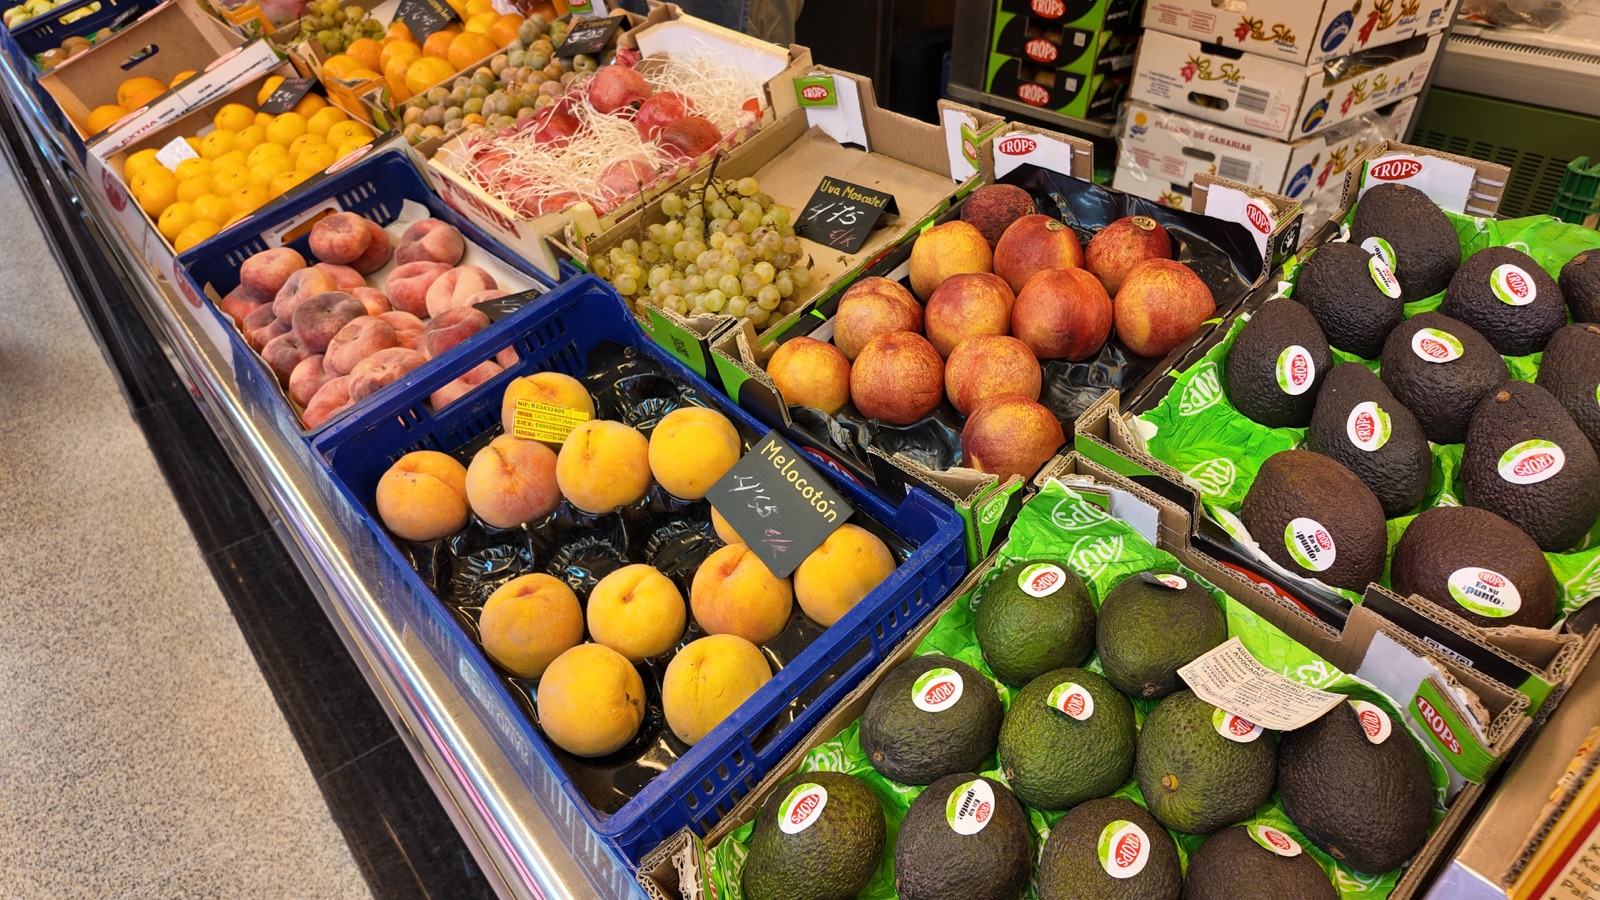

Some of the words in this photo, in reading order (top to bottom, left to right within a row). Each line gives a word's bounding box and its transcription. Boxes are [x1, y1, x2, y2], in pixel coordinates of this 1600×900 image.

[1032, 0, 1064, 17] TROPS
[1025, 41, 1058, 61] TROPS
[802, 86, 828, 100] TROPS
[1018, 84, 1049, 105] TROPS
[121, 119, 159, 146] EXTRA
[1193, 131, 1205, 140] DE
[1208, 135, 1252, 153] CANARIAS
[1001, 138, 1036, 155] TROPS
[1374, 161, 1420, 177] TROPS
[820, 179, 841, 197] Uva
[841, 185, 887, 208] Moscatel
[1247, 205, 1271, 233] TROPS
[1507, 271, 1528, 298] TROPS
[1420, 339, 1448, 359] TROPS
[1294, 355, 1306, 386] TROPS
[1356, 412, 1373, 442] TROPS
[1514, 453, 1555, 476] TROPS
[760, 439, 838, 524] Melocotón
[1307, 534, 1315, 545] En
[1313, 544, 1321, 553] su
[1316, 530, 1332, 551] TROPS
[1032, 571, 1059, 592] TROPS
[1474, 581, 1488, 590] En
[1488, 586, 1500, 595] su
[1478, 572, 1506, 588] TROPS
[1462, 584, 1505, 607] ¡punto!
[1225, 651, 1247, 676] EXPEDIDOR
[1233, 651, 1265, 678] AVOCADO
[1236, 646, 1269, 676] AGUACATE
[1200, 666, 1222, 690] CATEGORY
[1213, 664, 1229, 683] PACKER
[925, 681, 955, 705] TROPS
[1416, 697, 1461, 755] TROPS
[791, 794, 819, 824] TROPS
[958, 788, 976, 820] ¡punto!
[968, 807, 975, 817] su
[974, 798, 981, 808] En
[976, 801, 990, 823] TROPS
[1117, 833, 1140, 868] TROPS
